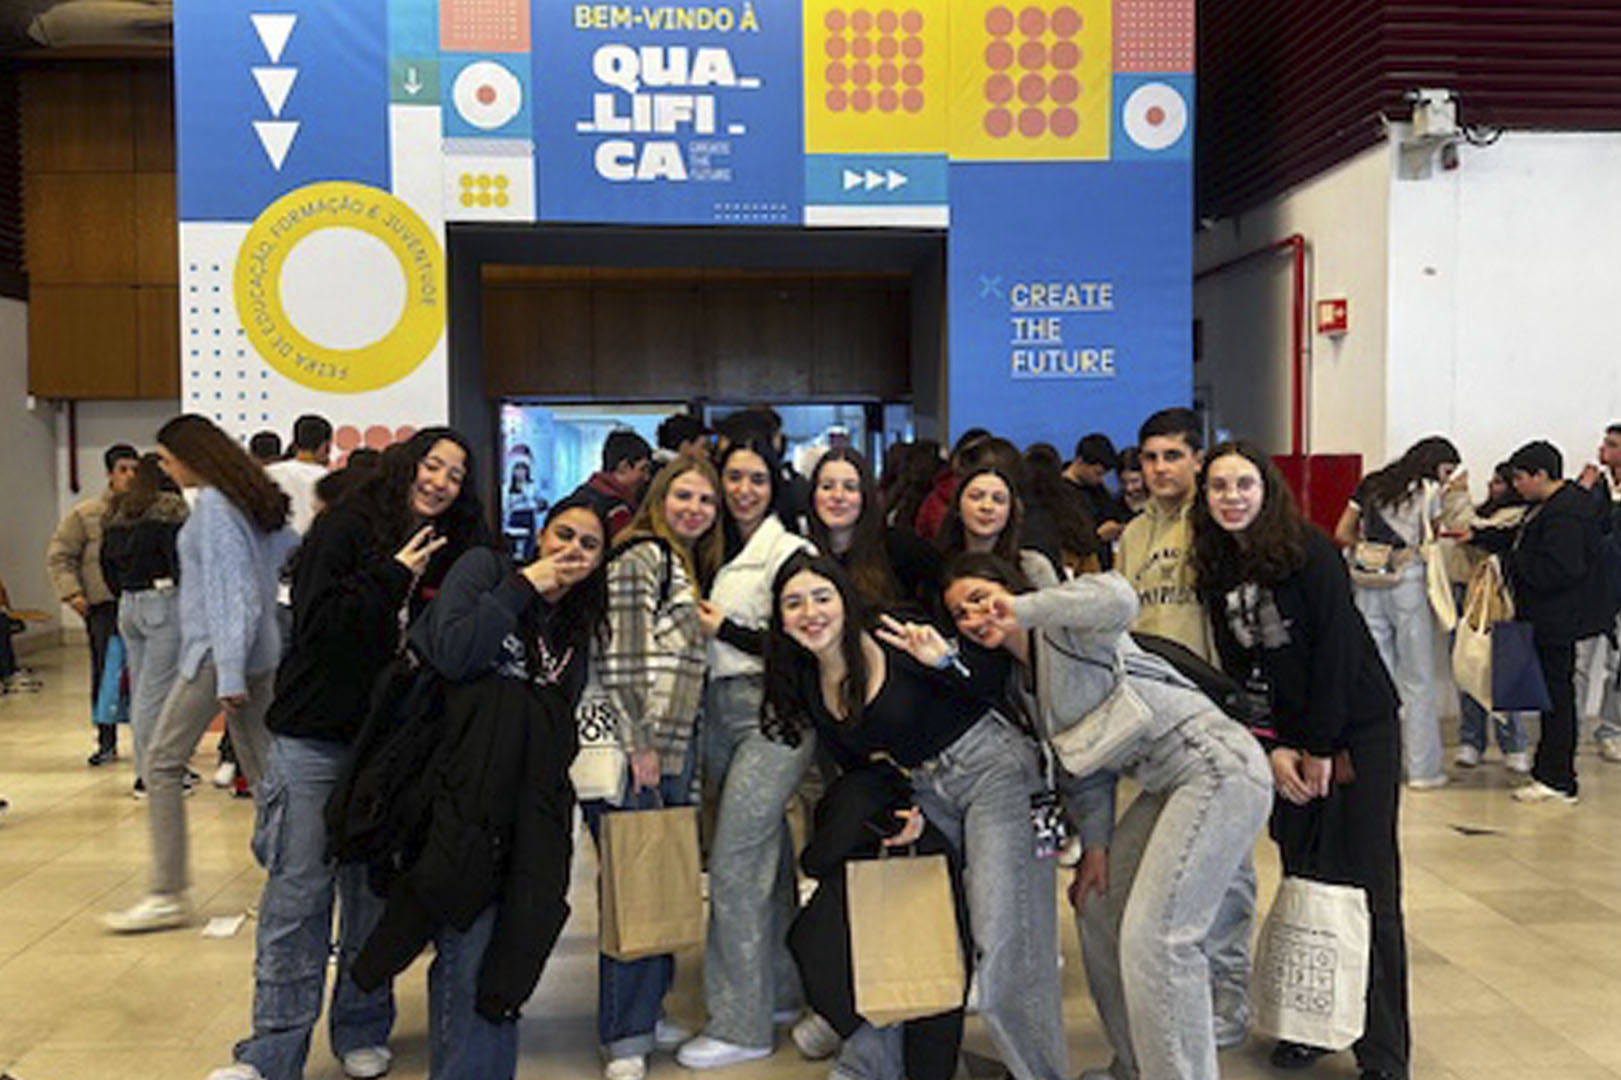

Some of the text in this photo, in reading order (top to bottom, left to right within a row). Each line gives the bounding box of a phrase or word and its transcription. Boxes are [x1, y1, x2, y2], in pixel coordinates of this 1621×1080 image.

[575, 2, 760, 31] BEM-VINDO À
[595, 140, 688, 181] CA
[270, 195, 365, 238] FORMAÇÃO
[383, 212, 437, 306] JUVENTUDE
[1011, 283, 1114, 307] CREATE
[1010, 317, 1061, 342] THE
[272, 336, 294, 358] DE
[296, 352, 349, 380] FEIRA
[1012, 349, 1116, 374] FUTURE
